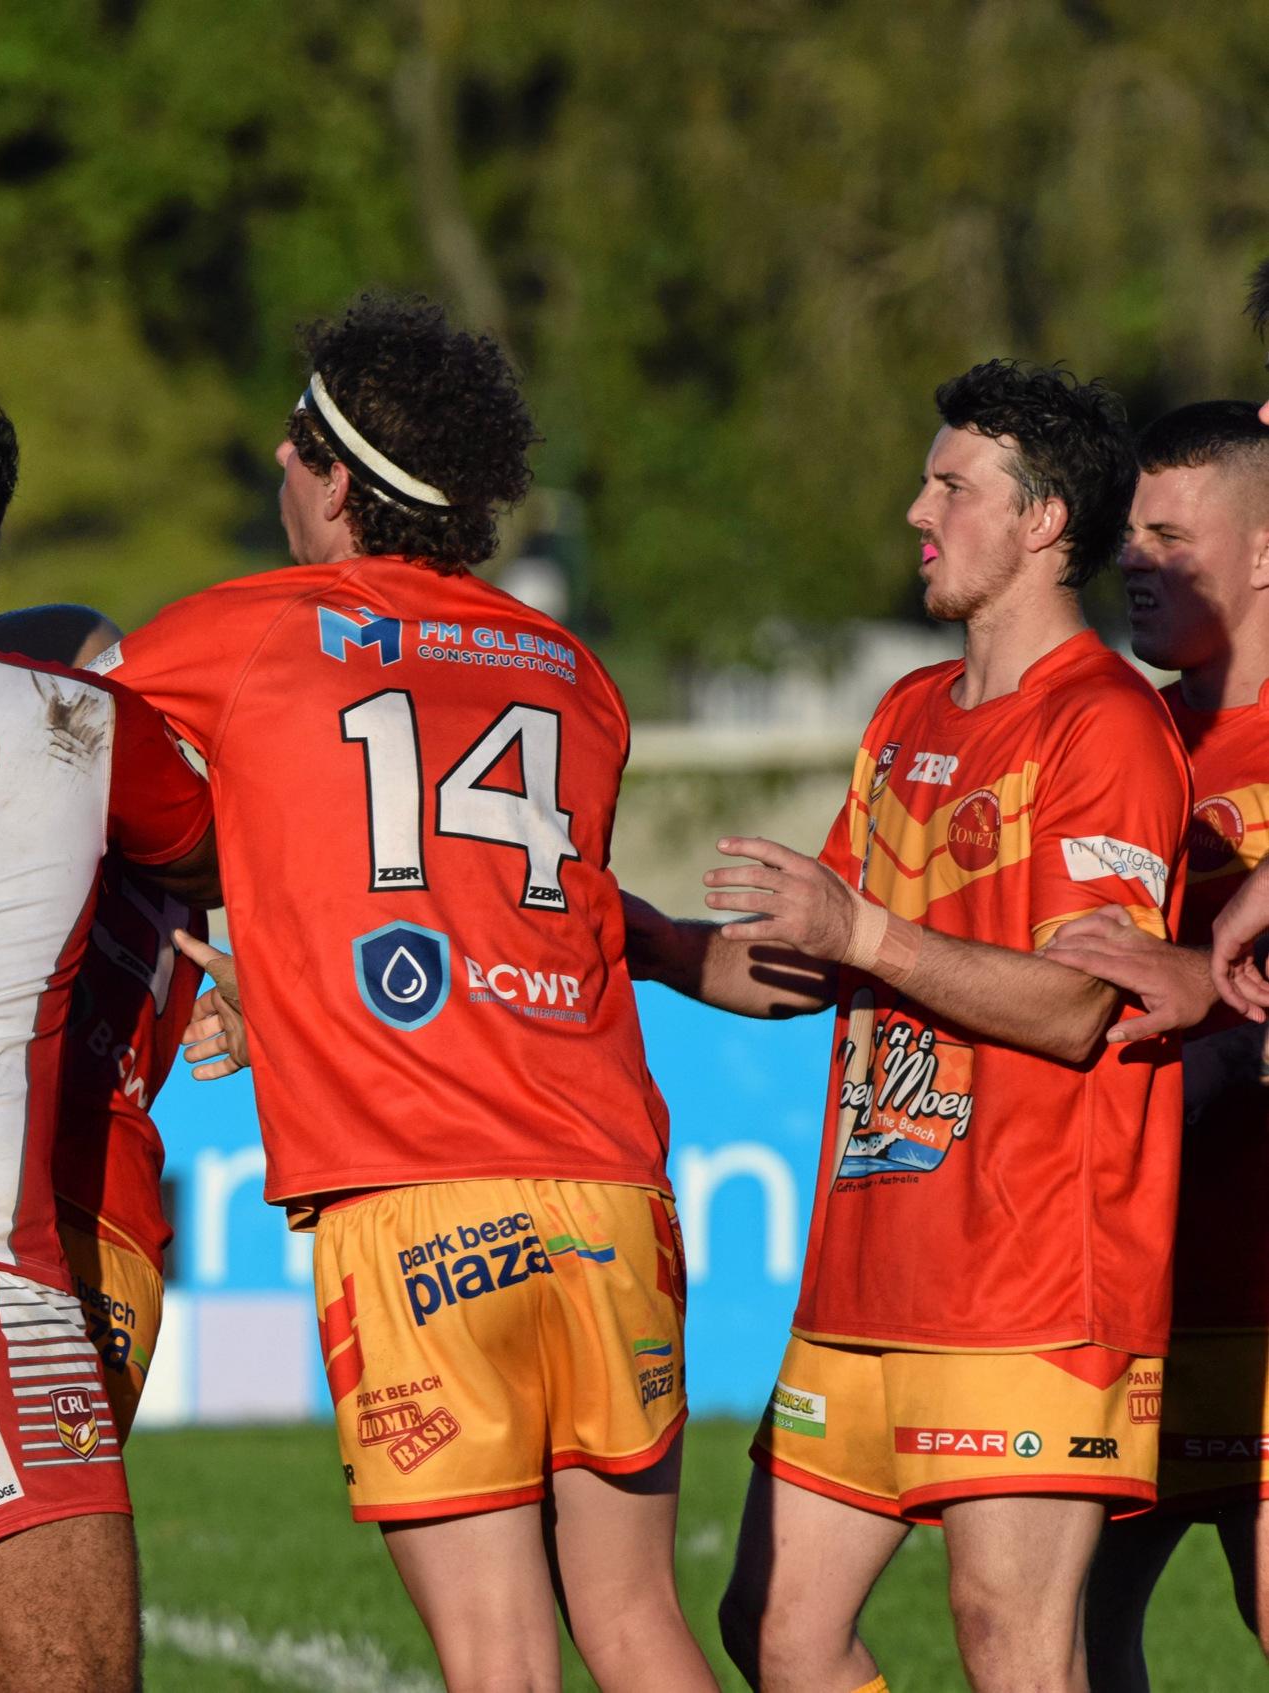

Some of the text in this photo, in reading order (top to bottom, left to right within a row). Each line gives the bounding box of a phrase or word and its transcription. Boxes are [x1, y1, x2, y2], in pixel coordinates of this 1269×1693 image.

[419, 620, 576, 669] FM GLENN
[418, 645, 576, 685] CONSTRUCTIONS
[878, 748, 896, 765] RL
[906, 752, 959, 786] ZBR
[339, 687, 581, 914] 14
[377, 867, 420, 881] ZBR
[528, 885, 563, 902] ZBR
[464, 956, 580, 1007] BCWP
[877, 1046, 974, 1137] Moey
[877, 1114, 936, 1143] The Beach
[398, 1211, 535, 1276] park beac
[404, 1235, 555, 1327] plaza
[386, 1375, 443, 1400] BEACH
[641, 1374, 674, 1410] plaza
[1127, 1371, 1162, 1386] PARK
[57, 1395, 91, 1415] CRL
[361, 1408, 421, 1440] HOME
[393, 1413, 456, 1468] BASE
[917, 1432, 1005, 1453] SPAR
[1068, 1436, 1119, 1459] ZBR
